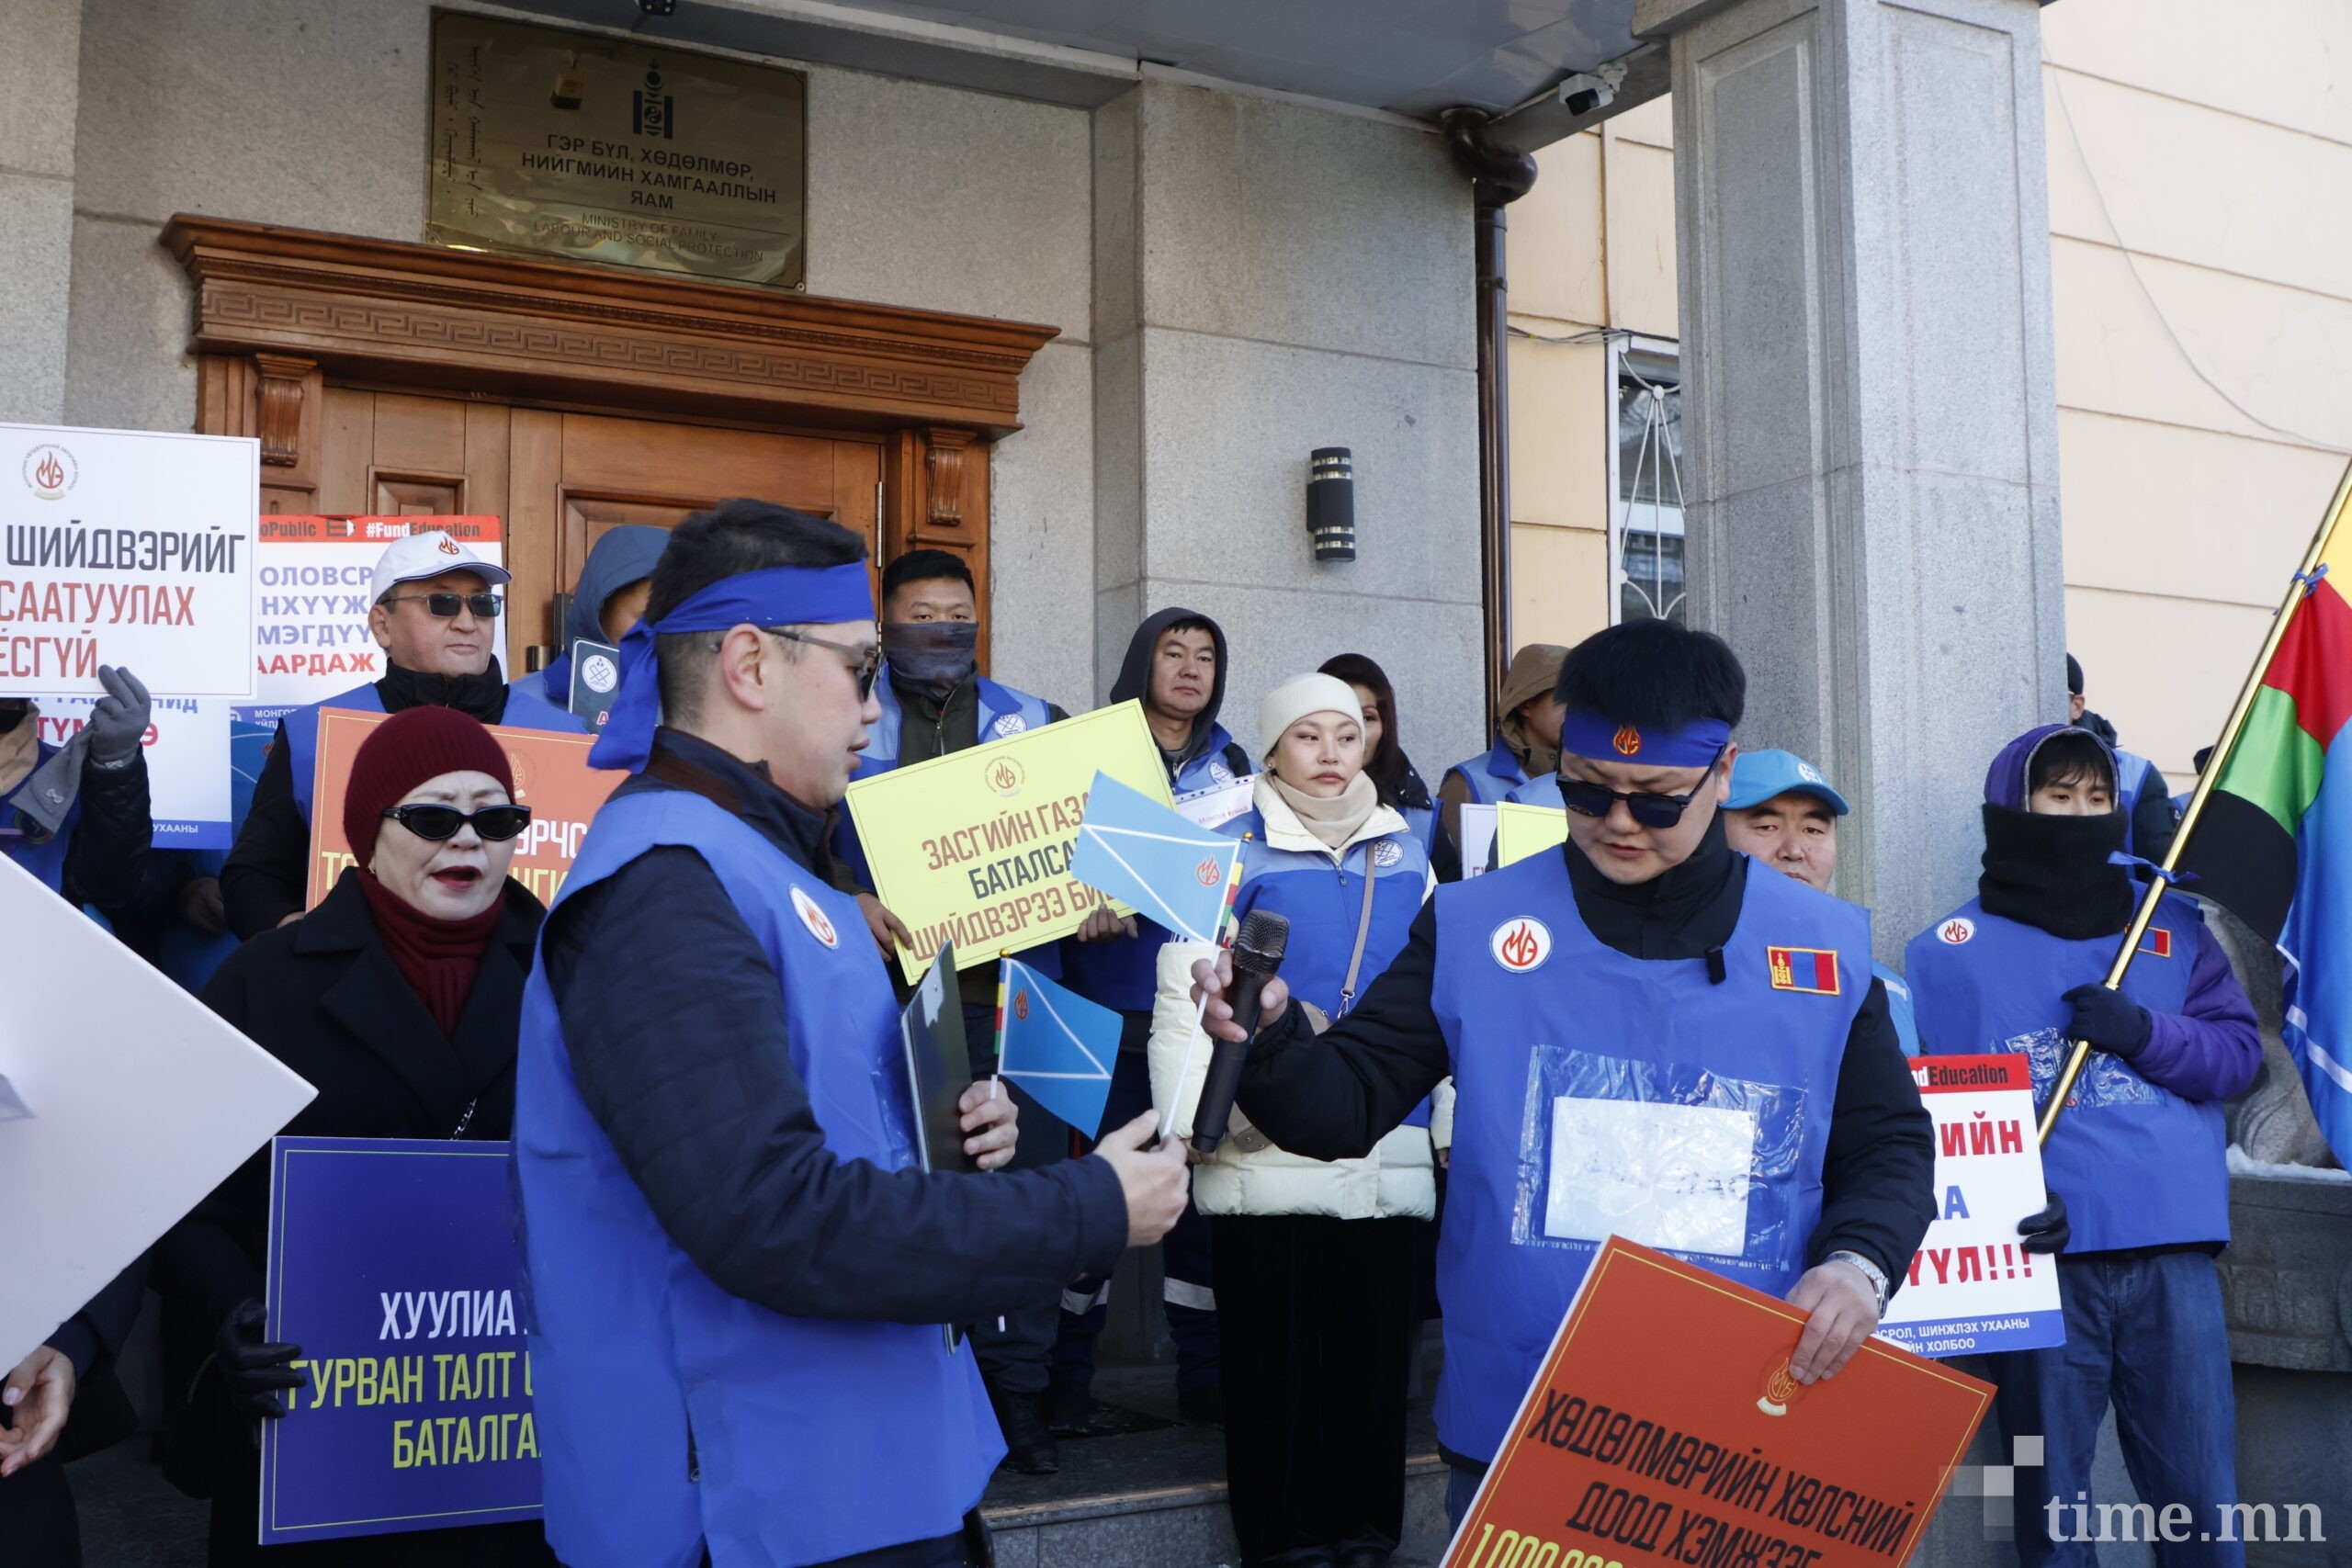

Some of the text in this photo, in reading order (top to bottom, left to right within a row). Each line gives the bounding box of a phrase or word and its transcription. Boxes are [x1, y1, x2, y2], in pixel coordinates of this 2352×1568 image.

[522, 152, 776, 204] НИЙГМИЙН ХАМГААЛЛЫН
[548, 134, 585, 153] ГЭР
[641, 148, 754, 181] ХӨДӨЛМӨР,
[630, 190, 674, 210] ЯАМ
[534, 220, 763, 263] LABOUR AND SOCIAL PROTECTION
[582, 212, 718, 242] MINISTRY OF FAMILY
[6, 519, 246, 574] ШИЙДВЭРИЙГ
[0, 580, 196, 626] СААТУУЛАХ
[258, 595, 369, 615] НХҮҮЖ
[922, 809, 1037, 871] ЗАСГИЙН
[967, 837, 1078, 900] БАТАЛСА
[910, 886, 1067, 962] ШИЙДВЭРЭЭ
[379, 1289, 516, 1341] ХУУЛИА
[1918, 1321, 1979, 1337] ШИНЖЛЭХ
[1981, 1317, 2030, 1332] УХААНЫ
[1927, 1337, 1975, 1352] ХОЛБОО
[287, 1355, 424, 1410] ГУРВАН
[433, 1351, 516, 1403] ТАЛТ
[393, 1413, 541, 1470] БАТАЛГА
[1527, 1388, 1916, 1557] ХӨДӨЛМӨРИЙН ХӨЛСНИЙ
[1565, 1481, 1673, 1552] ДООД
